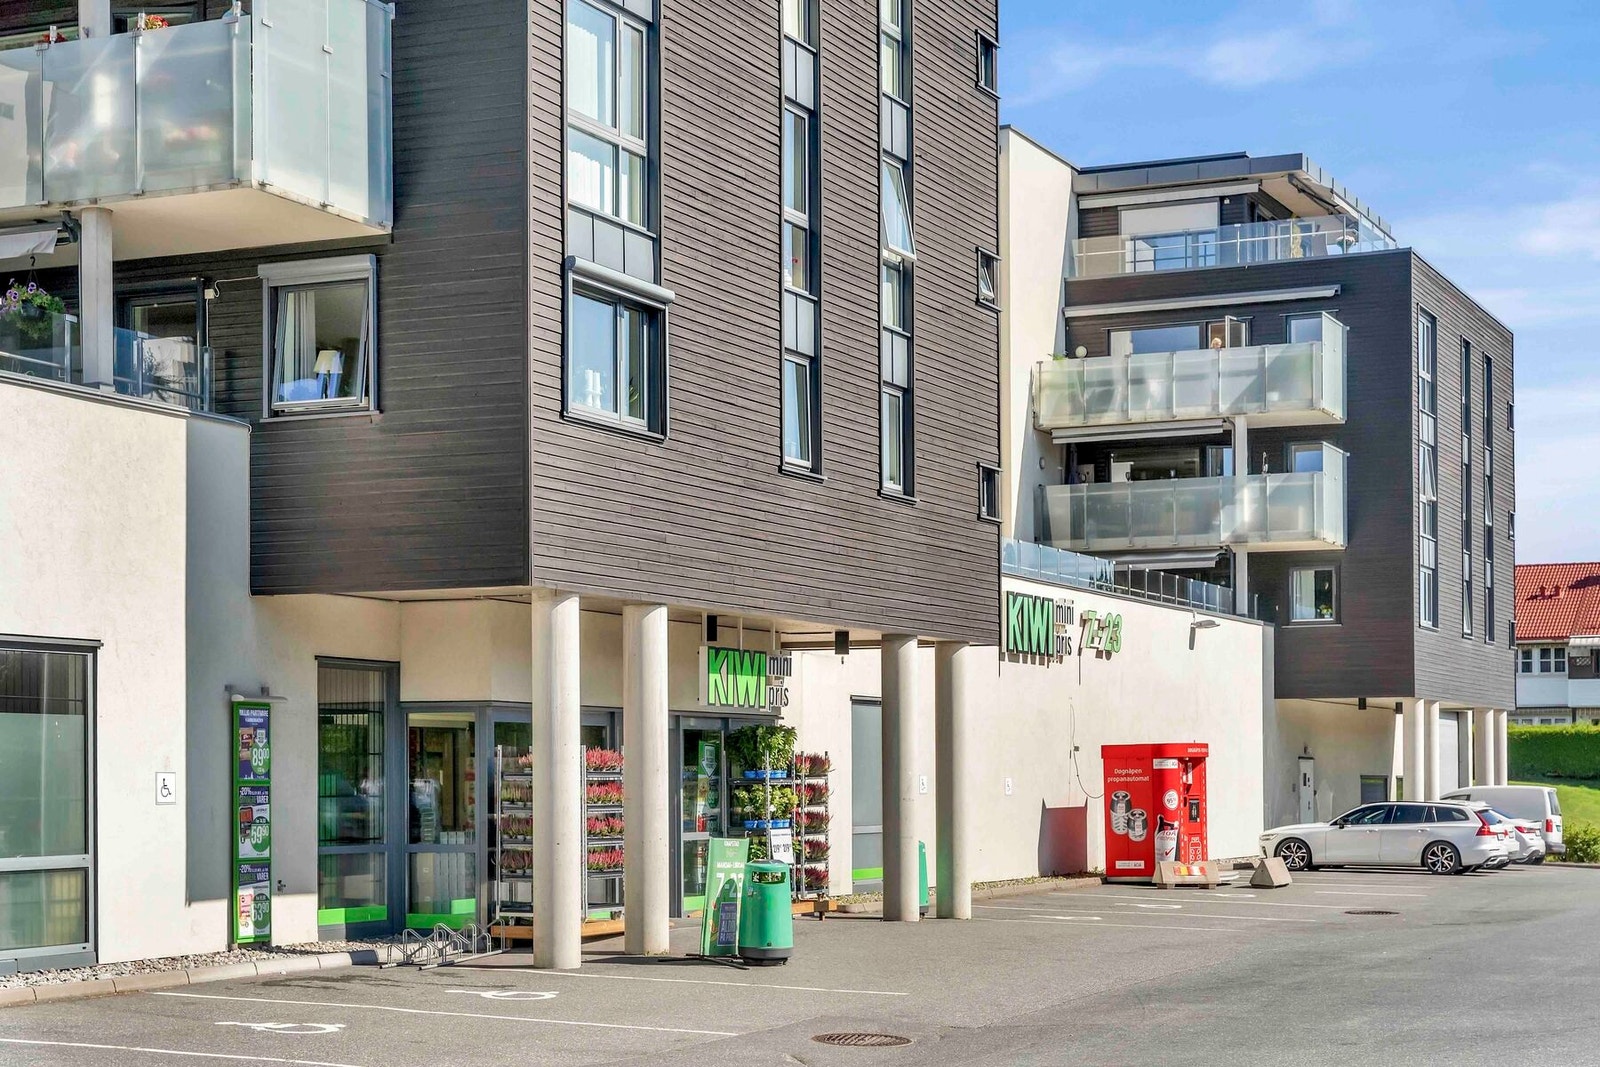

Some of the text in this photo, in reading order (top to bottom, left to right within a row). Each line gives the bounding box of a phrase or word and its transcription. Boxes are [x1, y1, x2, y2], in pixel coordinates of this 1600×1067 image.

[1007, 591, 1054, 657] KIWI
[1055, 600, 1074, 625] mini
[1055, 629, 1072, 656] pris
[1085, 610, 1122, 653] 7-23
[708, 646, 766, 708] KIWI
[768, 651, 792, 677] mini
[768, 681, 789, 711] pris
